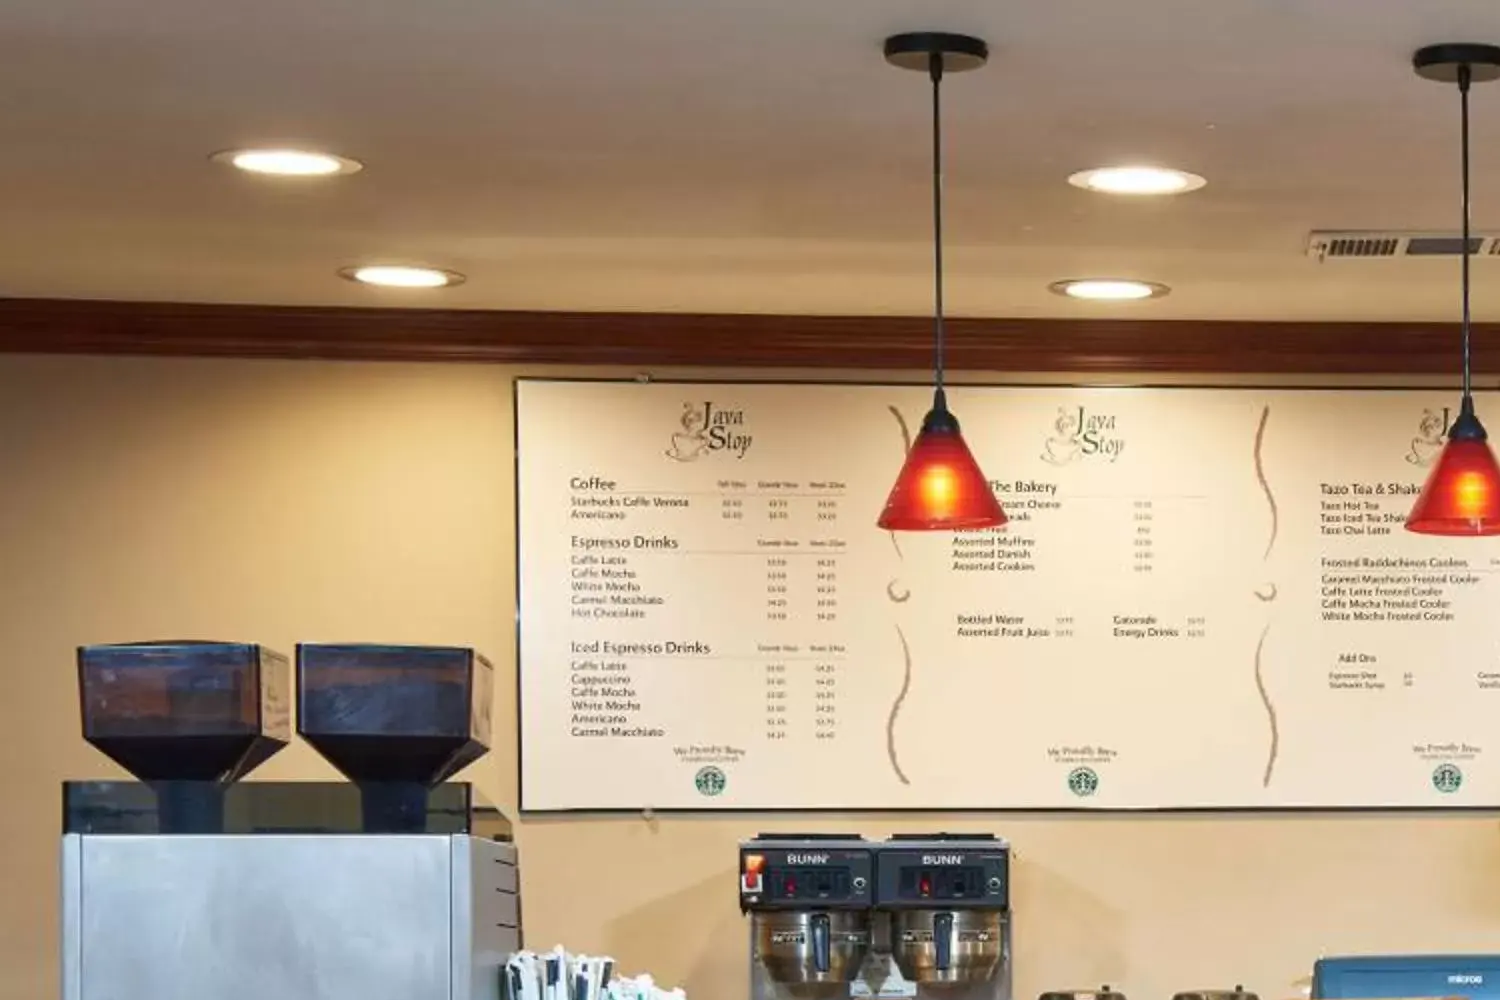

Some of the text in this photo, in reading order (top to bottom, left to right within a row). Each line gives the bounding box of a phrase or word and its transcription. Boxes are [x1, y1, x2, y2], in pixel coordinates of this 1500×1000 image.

[700, 401, 743, 433] Java
[1075, 406, 1116, 437] Java
[708, 425, 753, 459] Stop
[1081, 429, 1125, 463] Stop
[570, 477, 617, 490] Coffee
[1015, 481, 1057, 496] Bakery
[1320, 483, 1349, 495] Tazo
[1352, 483, 1373, 495] Tea
[1375, 483, 1385, 495] &
[571, 496, 620, 507] Starbucks
[653, 497, 690, 507] Verona
[1320, 501, 1380, 511] Tazo Hot Tea
[571, 509, 626, 520] Americano
[1320, 513, 1342, 523] Tazo
[1343, 513, 1363, 523] Iced
[1365, 514, 1381, 523] Tea
[1320, 525, 1342, 535] Tazo
[1367, 526, 1391, 535] Latte
[571, 535, 679, 550] Espresso Drinks
[952, 537, 995, 547] Assorted
[952, 549, 1031, 560] Assorted Danish
[601, 556, 627, 565] Latte
[952, 562, 1036, 572] Assorted Cookies
[601, 568, 637, 578] Mocha
[571, 581, 641, 591] White Mocha
[1349, 587, 1373, 596] Latte
[1349, 600, 1381, 609] Mocha
[571, 607, 646, 619] Hot Chocolate
[1321, 611, 1351, 621] White
[1353, 611, 1386, 621] Mocha
[957, 614, 1024, 625] Bottled Water
[1147, 627, 1179, 637] Drinks
[571, 640, 711, 656] Iced Espresso Drinks
[601, 661, 627, 671] Latte
[601, 687, 636, 697] Mocha
[571, 700, 641, 711] White Mocha
[571, 713, 627, 724] Americano
[787, 854, 828, 865] BUNN
[922, 854, 963, 865] BUNN
